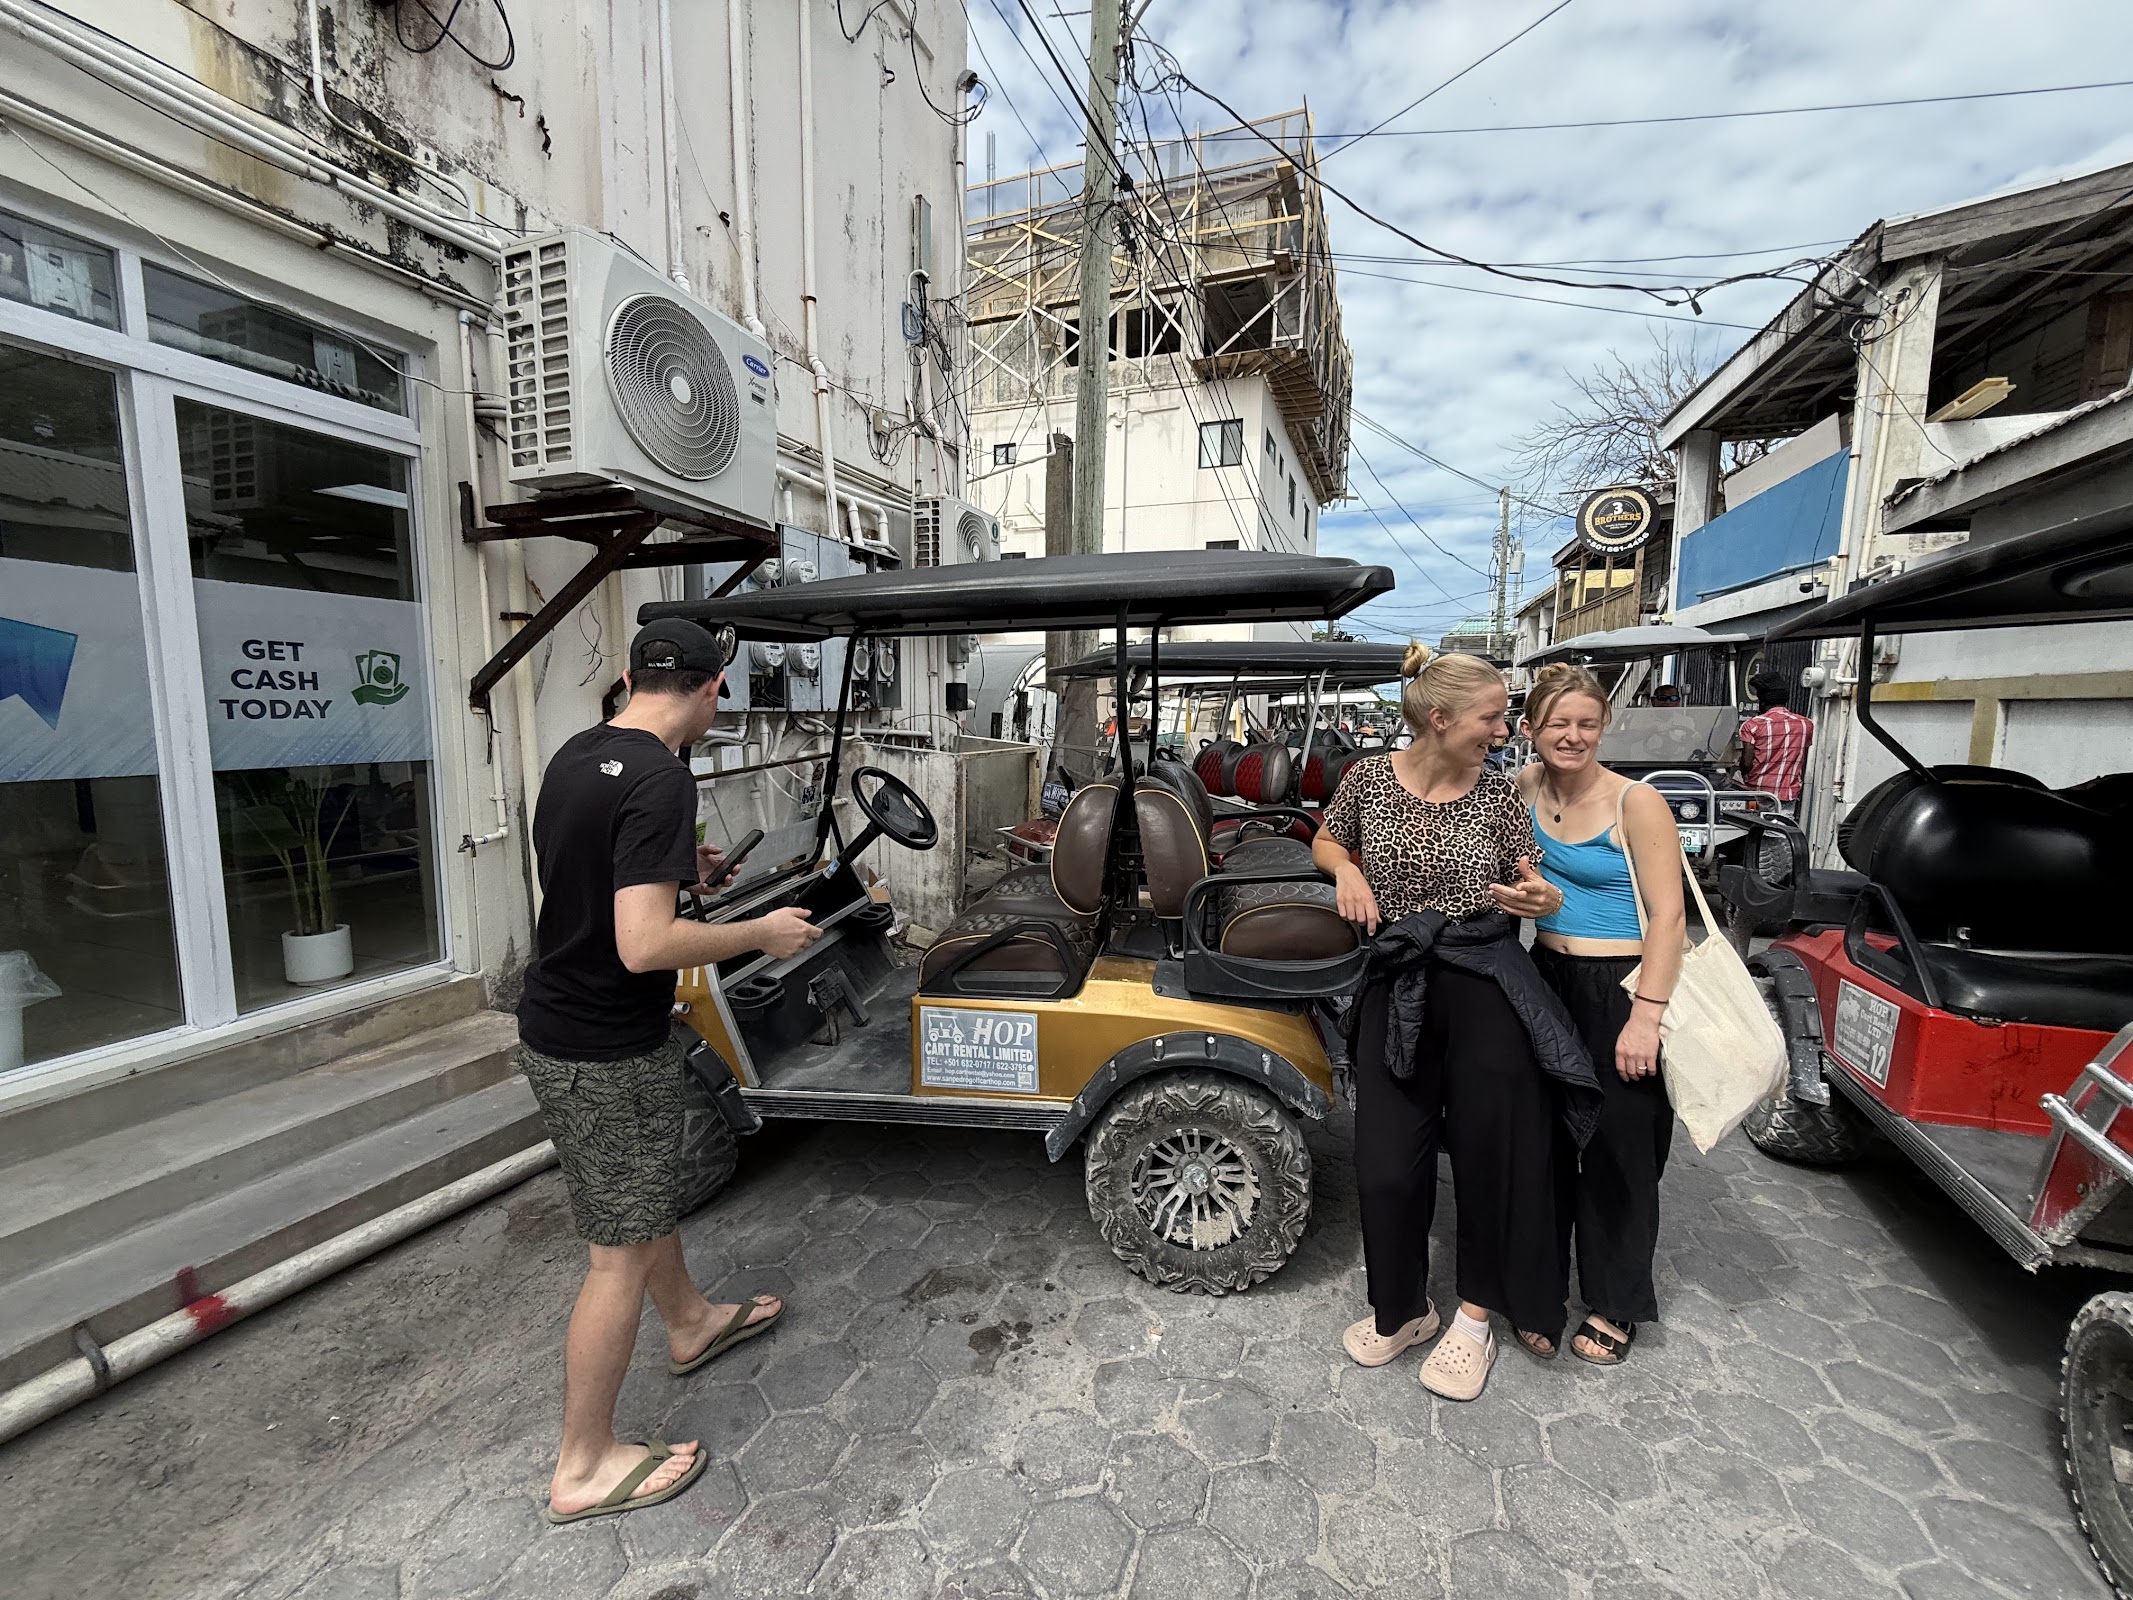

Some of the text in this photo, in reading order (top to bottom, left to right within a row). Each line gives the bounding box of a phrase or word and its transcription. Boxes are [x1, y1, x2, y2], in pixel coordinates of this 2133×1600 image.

[746, 358, 767, 374] Carrier
[1612, 501, 1624, 515] 3
[1594, 512, 1642, 526] BROTHERS
[241, 639, 304, 662] GET
[230, 669, 319, 691] CASH
[218, 699, 333, 720] TODAY
[1869, 1000, 1889, 1018] HOP
[970, 1017, 1033, 1046] HOP
[1867, 1025, 1882, 1039] LTD
[925, 1041, 1034, 1062] CART RENTAL LIMITED
[1870, 1042, 1887, 1080] 12
[926, 1056, 942, 1066] TEL:
[943, 1058, 960, 1067] +501
[996, 1062, 1027, 1072] 622-3795
